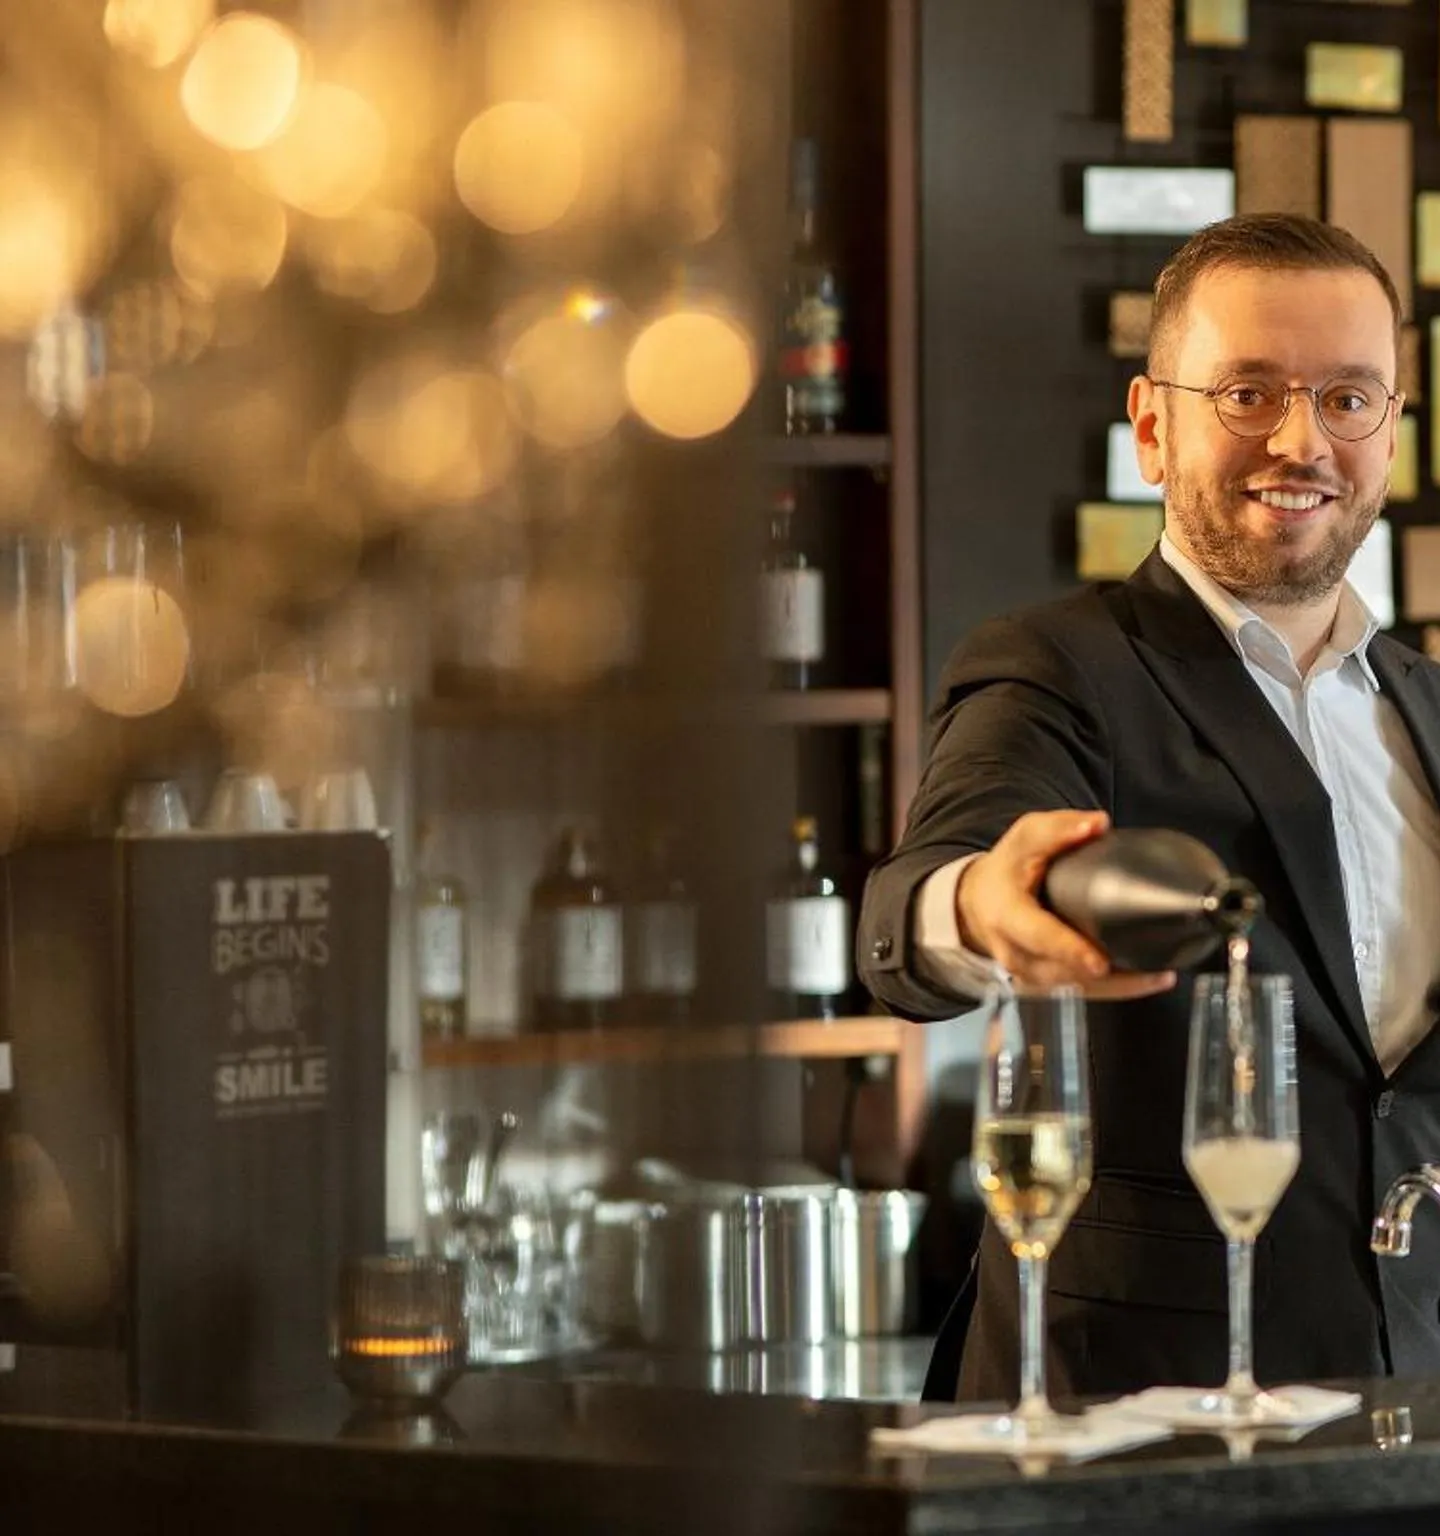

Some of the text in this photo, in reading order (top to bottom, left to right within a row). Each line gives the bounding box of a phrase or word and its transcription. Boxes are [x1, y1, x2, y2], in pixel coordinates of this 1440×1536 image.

[214, 875, 330, 923] LIFE
[213, 924, 330, 975] BEGINS
[214, 1058, 329, 1103] SMILE
